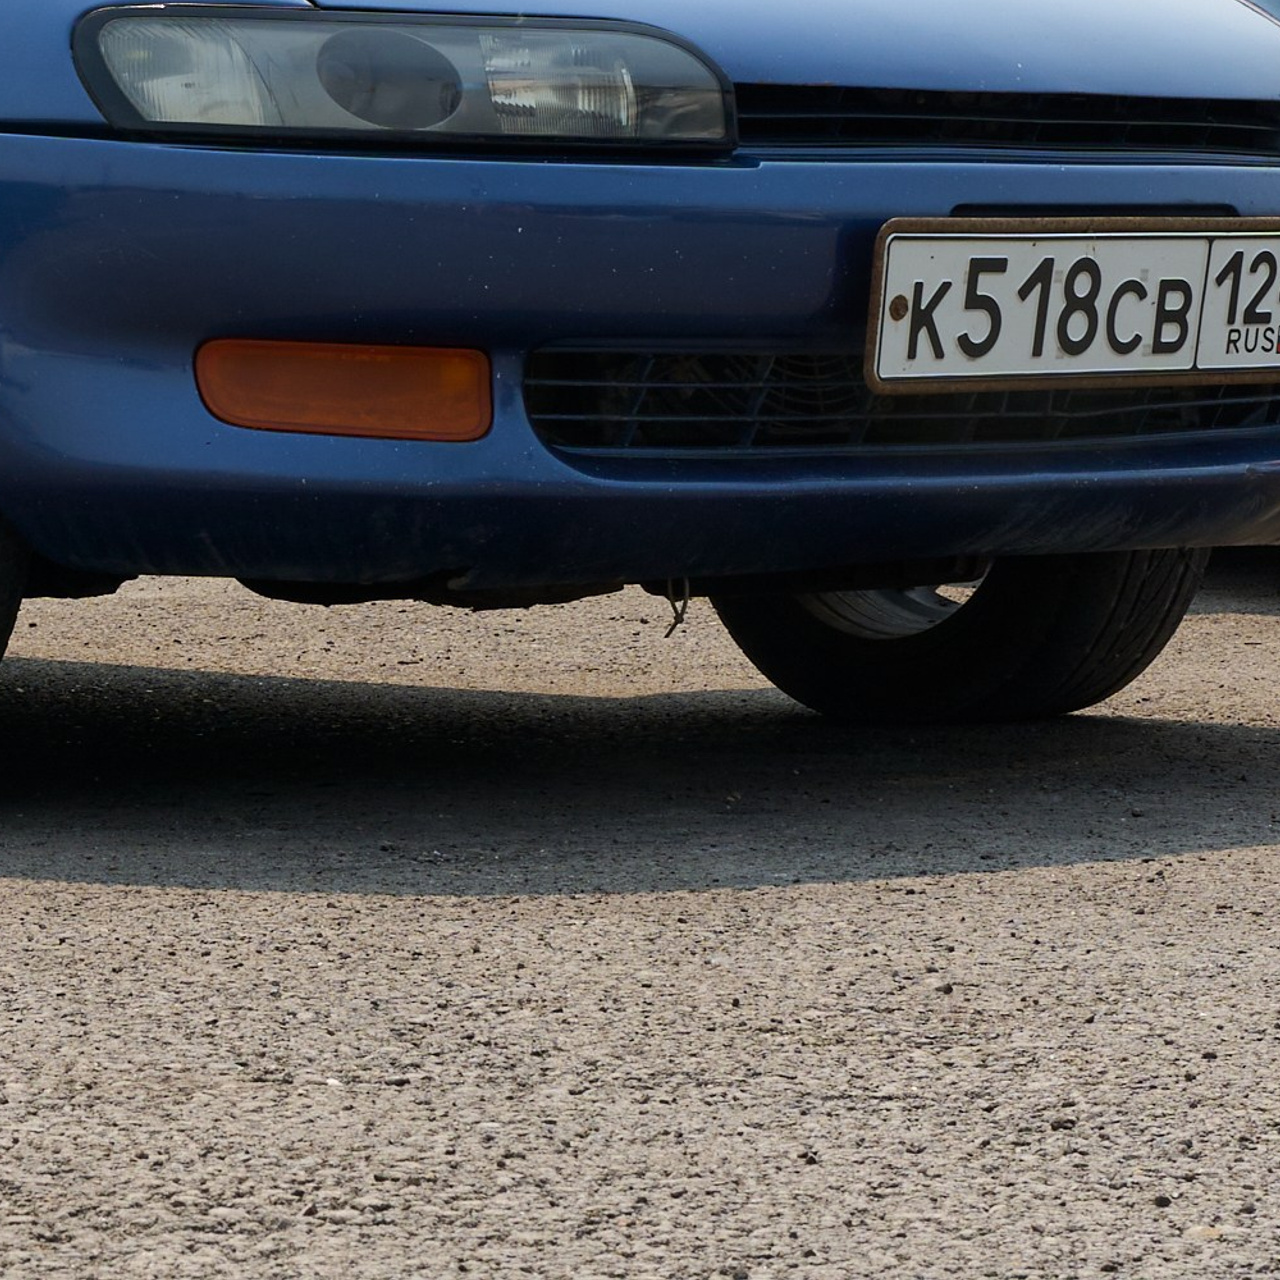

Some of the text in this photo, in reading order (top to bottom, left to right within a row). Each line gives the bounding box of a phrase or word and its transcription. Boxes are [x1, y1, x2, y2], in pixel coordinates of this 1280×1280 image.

[906, 250, 1280, 360] K518CB 12
[1225, 328, 1275, 354] RUS
